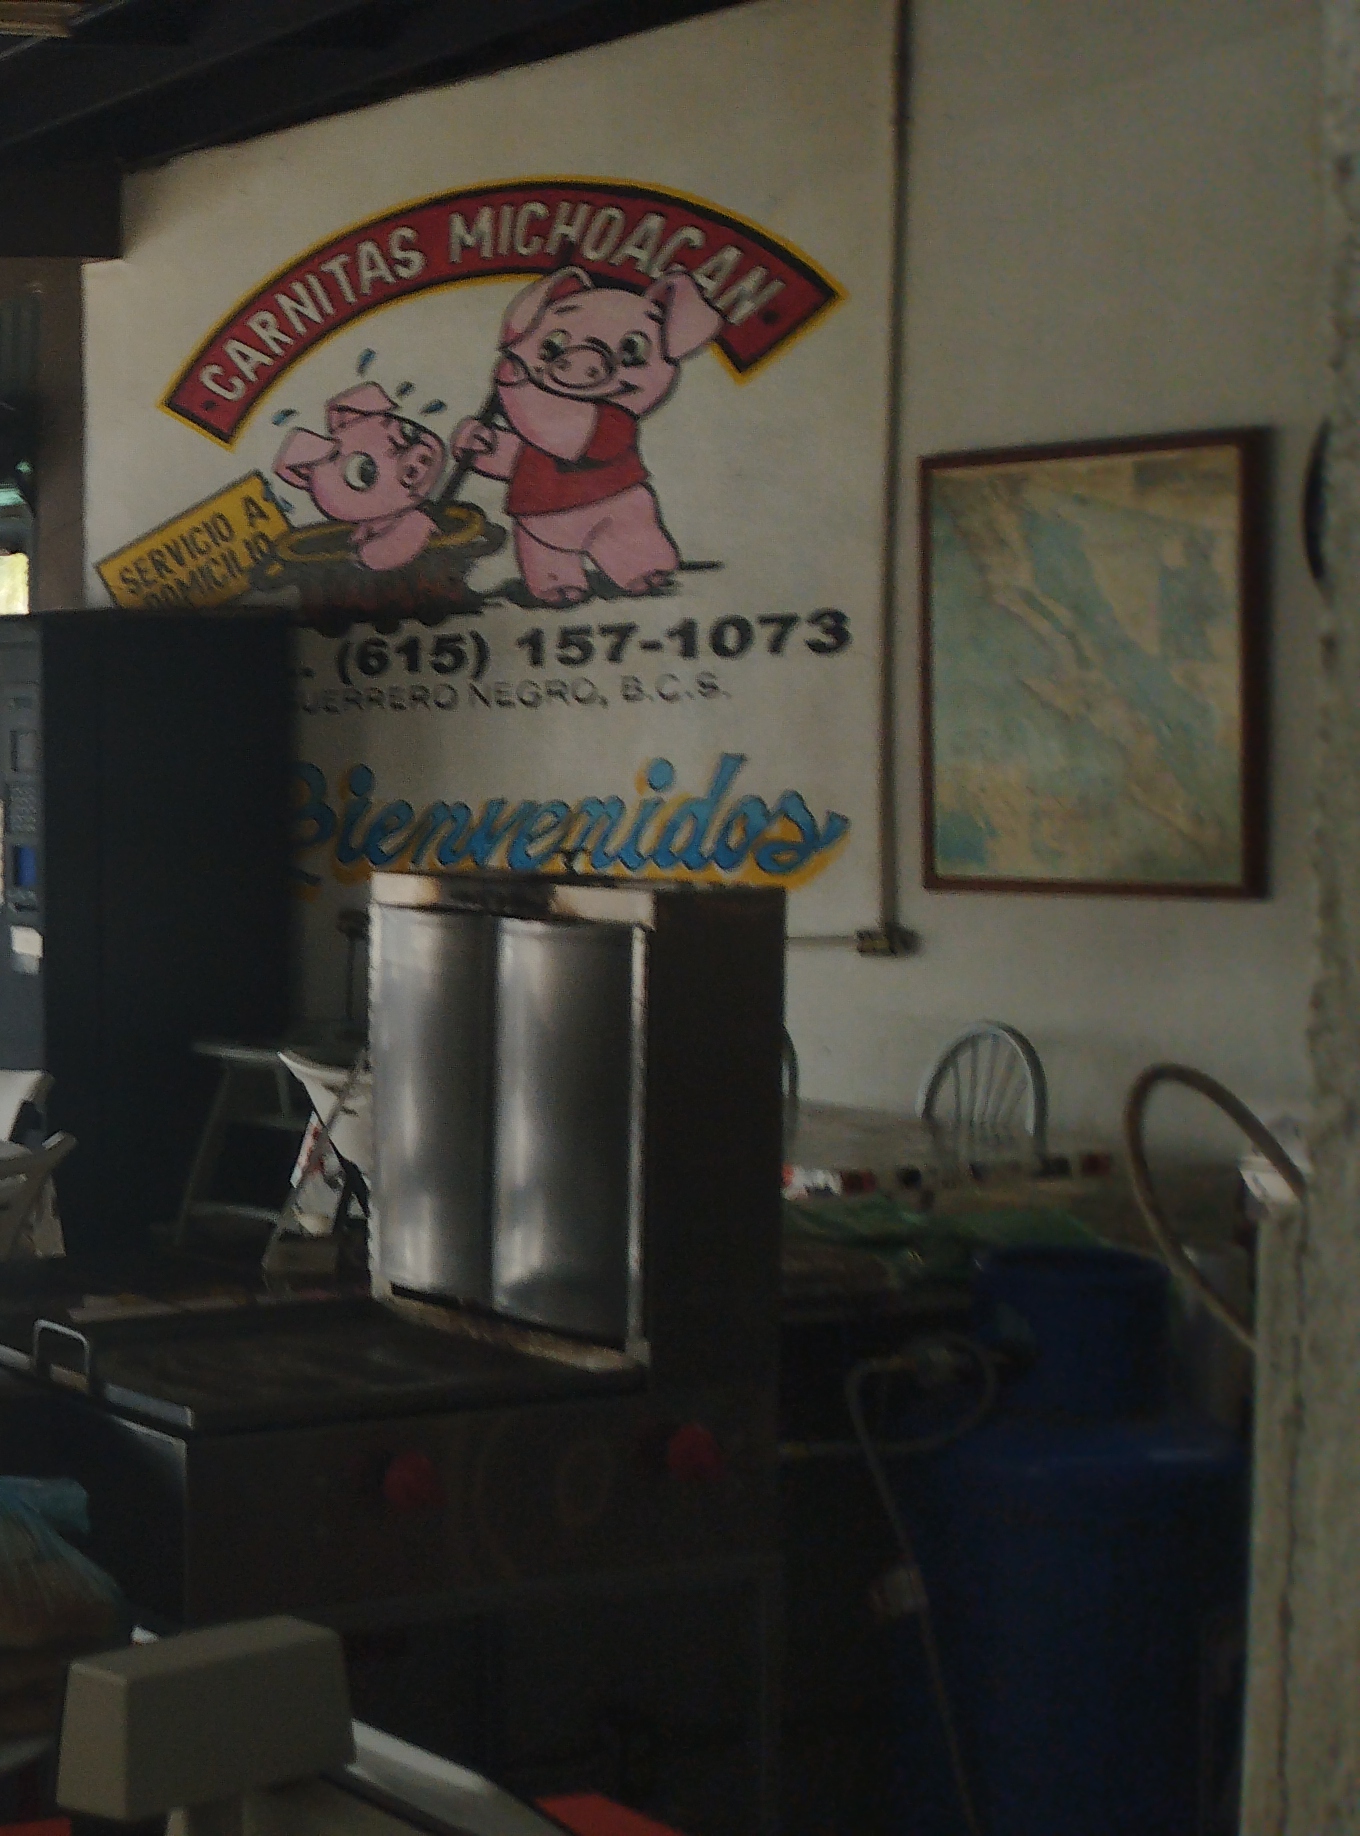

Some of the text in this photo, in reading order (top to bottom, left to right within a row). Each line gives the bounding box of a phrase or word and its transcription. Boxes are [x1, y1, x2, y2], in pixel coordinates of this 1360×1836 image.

[198, 200, 787, 403] CARNITAS MICHOACAN
[118, 495, 271, 596] SERVICIO A
[337, 607, 853, 686] (615) 157-1073
[300, 682, 460, 715] UERRERO
[468, 675, 610, 710] NEGRO,
